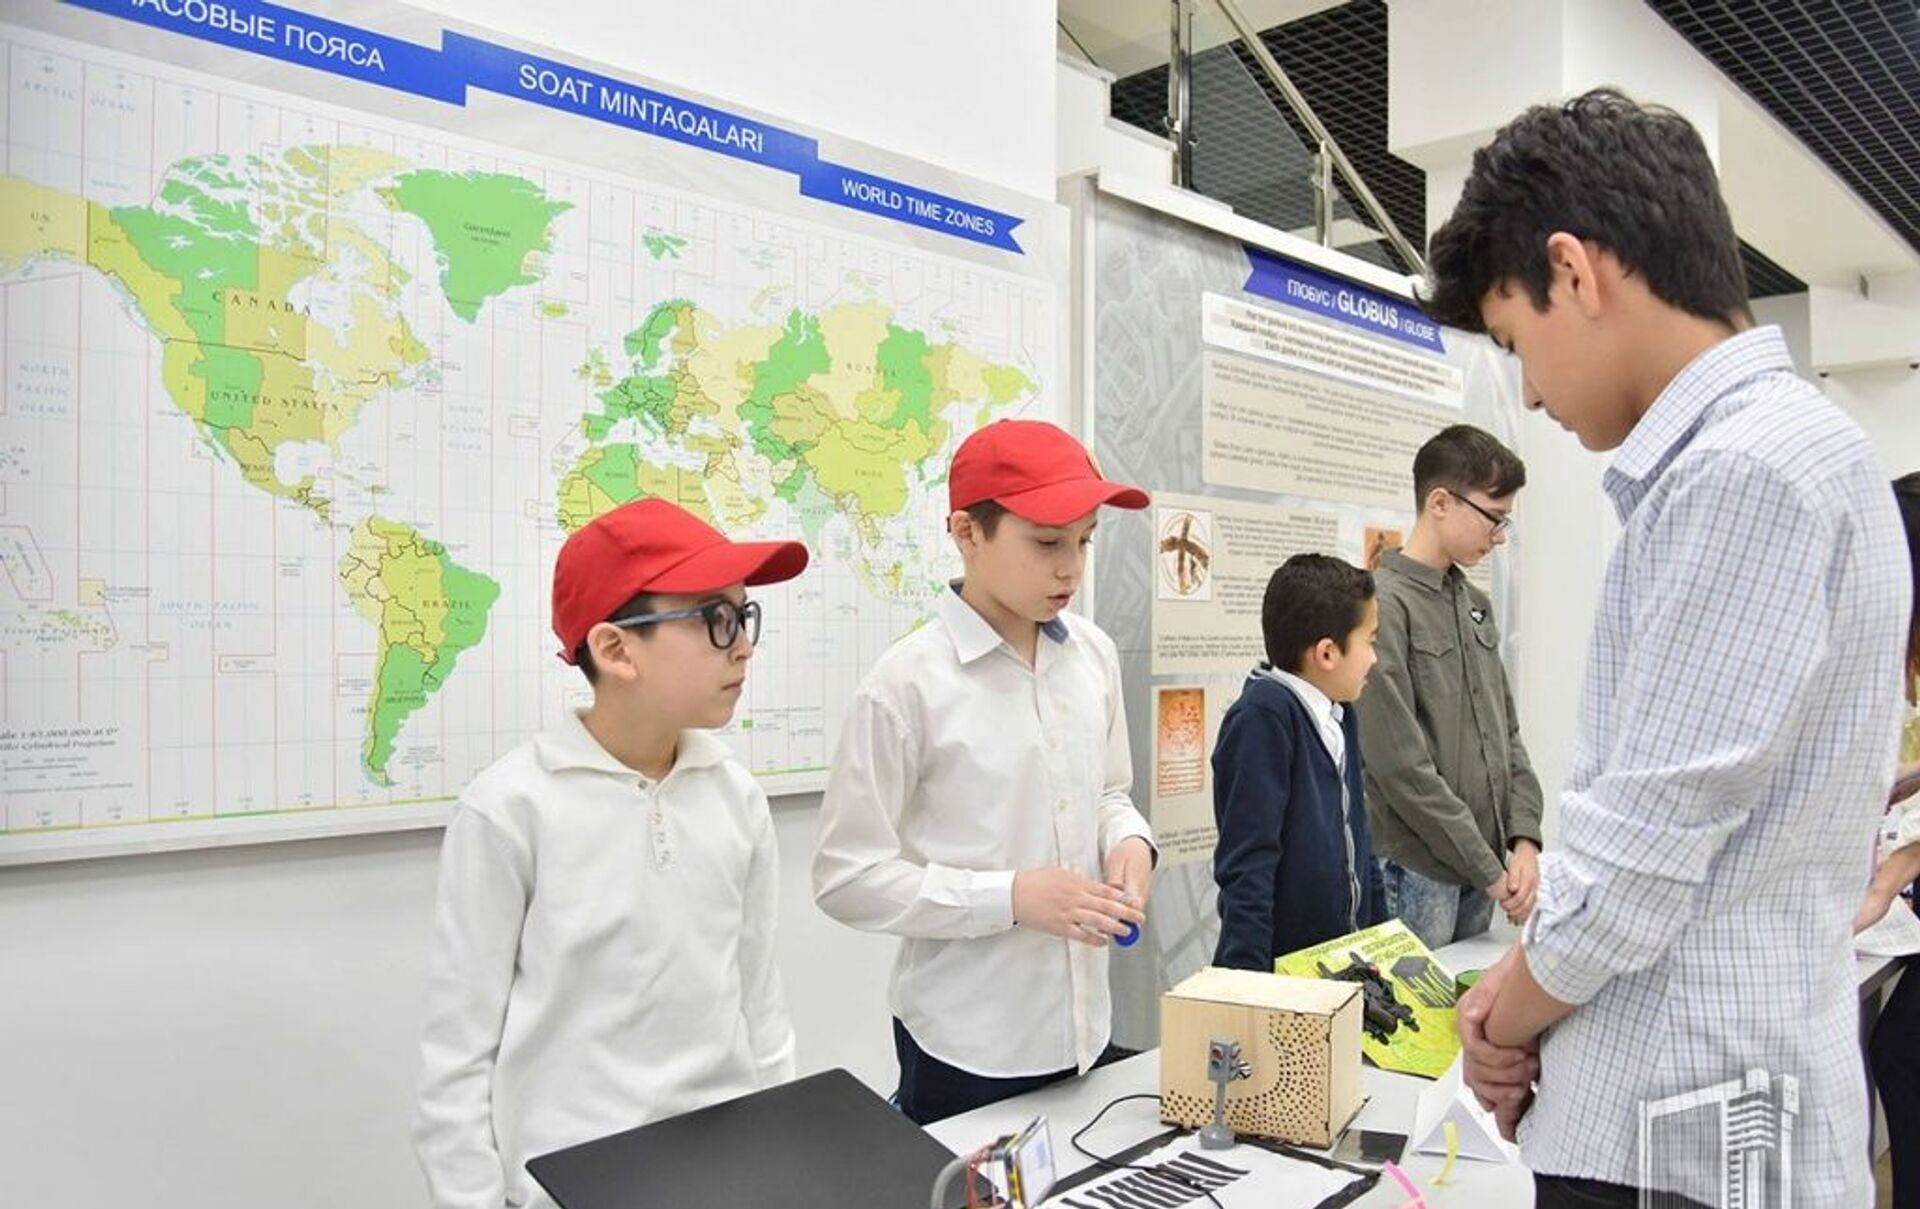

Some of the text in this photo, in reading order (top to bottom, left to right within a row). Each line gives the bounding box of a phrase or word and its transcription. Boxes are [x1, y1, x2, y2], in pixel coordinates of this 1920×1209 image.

[131, 0, 385, 72] АСОВЫЕ ПОЯСА
[519, 64, 763, 154] SOAT MINTAQALARI
[842, 178, 995, 236] WORLD TIME ZONES
[211, 290, 312, 316] CANADA
[1337, 289, 1399, 331] GLOBUS
[1405, 318, 1437, 343] GLOBE
[210, 390, 339, 414] UNITED STATES
